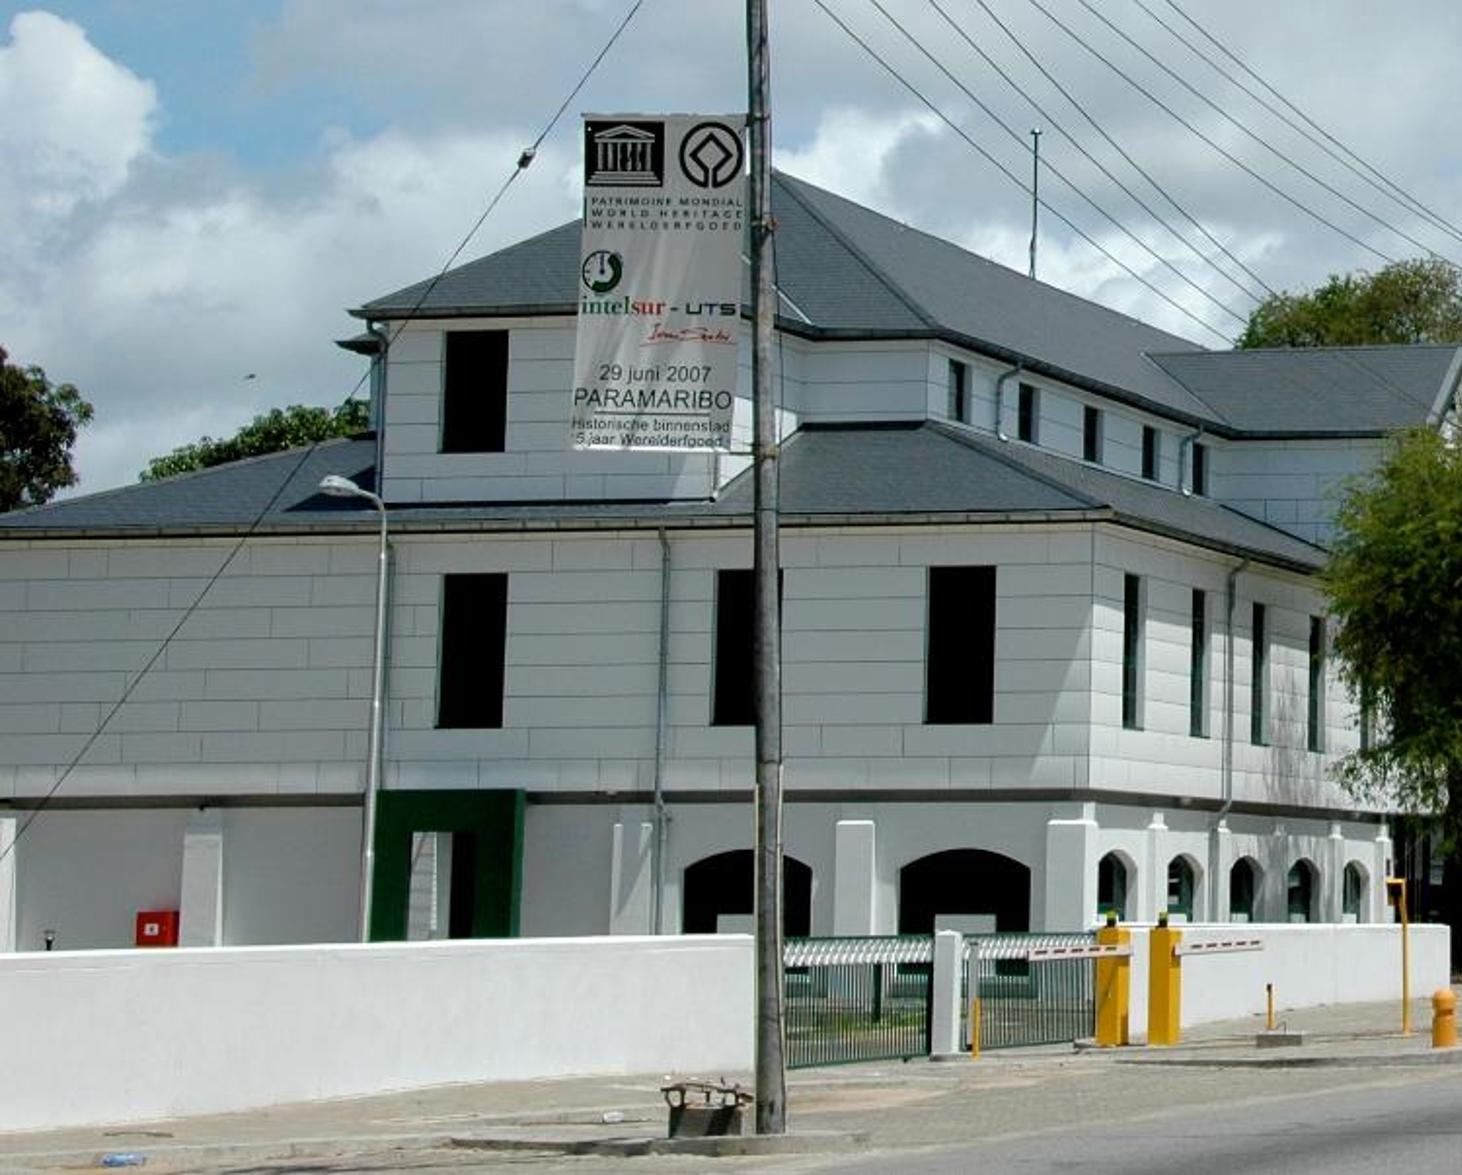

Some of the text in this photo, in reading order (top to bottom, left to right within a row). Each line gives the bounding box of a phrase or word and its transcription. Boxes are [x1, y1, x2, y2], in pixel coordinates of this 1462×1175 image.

[592, 197, 742, 206] PATRIMOINE MONDIAL
[592, 209, 742, 219] WORLD HERITAGE
[582, 296, 666, 315] intelsur
[686, 303, 736, 316] UTS
[600, 365, 712, 384] 29 juni 2007
[574, 388, 732, 410] PARAMARIBO
[571, 416, 730, 433] Historische binnenstad
[588, 434, 615, 446] jaar
